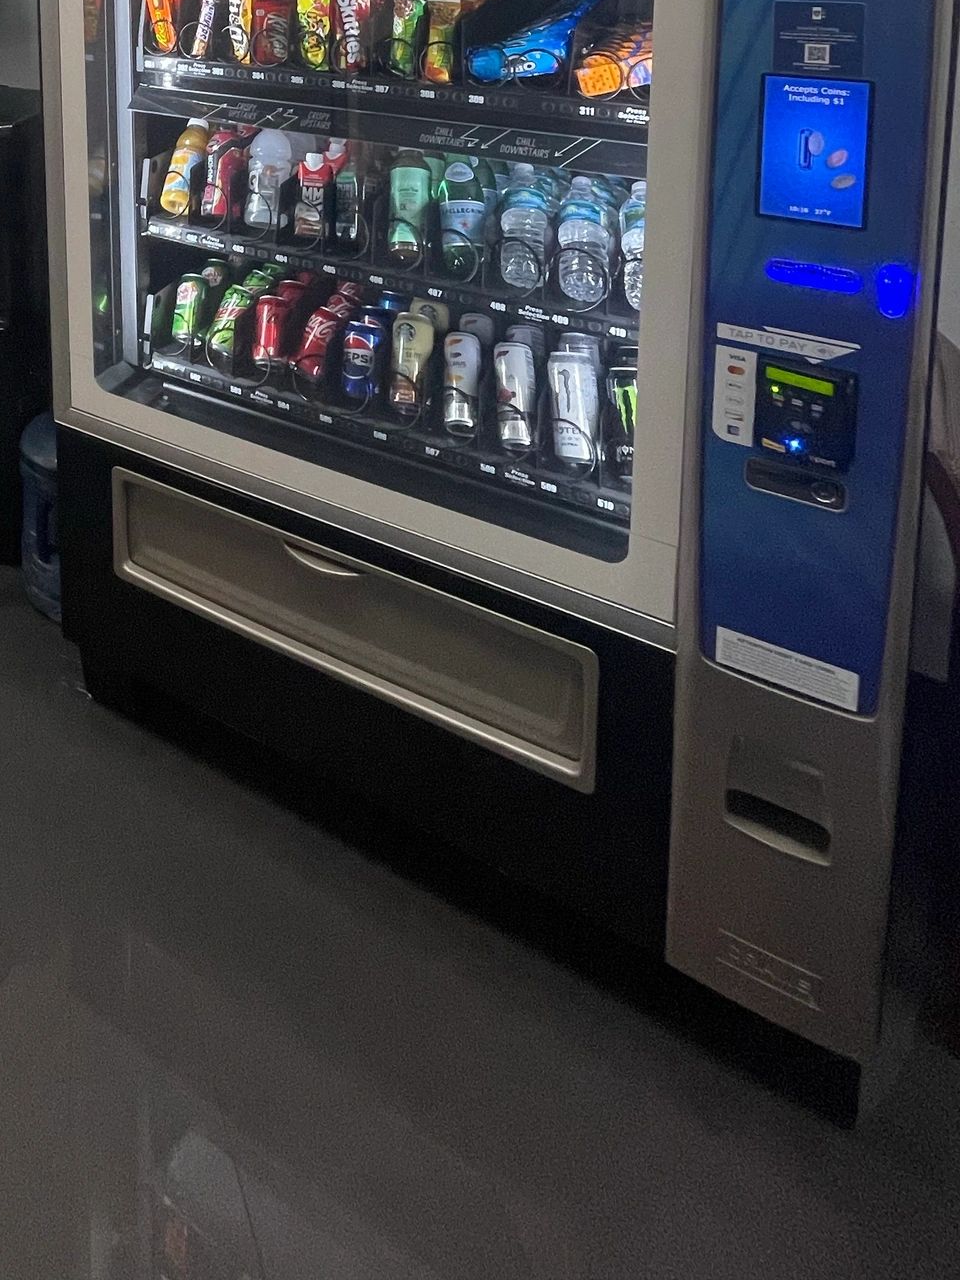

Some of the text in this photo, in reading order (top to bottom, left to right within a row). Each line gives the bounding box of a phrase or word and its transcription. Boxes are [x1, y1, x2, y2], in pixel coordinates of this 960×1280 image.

[252, 72, 265, 80] 304
[784, 84, 850, 97] Accepts Coins:
[788, 94, 844, 105] Including $1
[579, 106, 595, 116] 311
[515, 136, 536, 146] CHILL
[500, 144, 550, 159] DOWNSTAIRS
[427, 288, 442, 297] 407
[518, 308, 550, 320] Selection
[609, 327, 627, 338] 410
[728, 327, 808, 352] TAP TO PAY
[729, 354, 746, 362] VISA
[597, 498, 614, 510] 510
